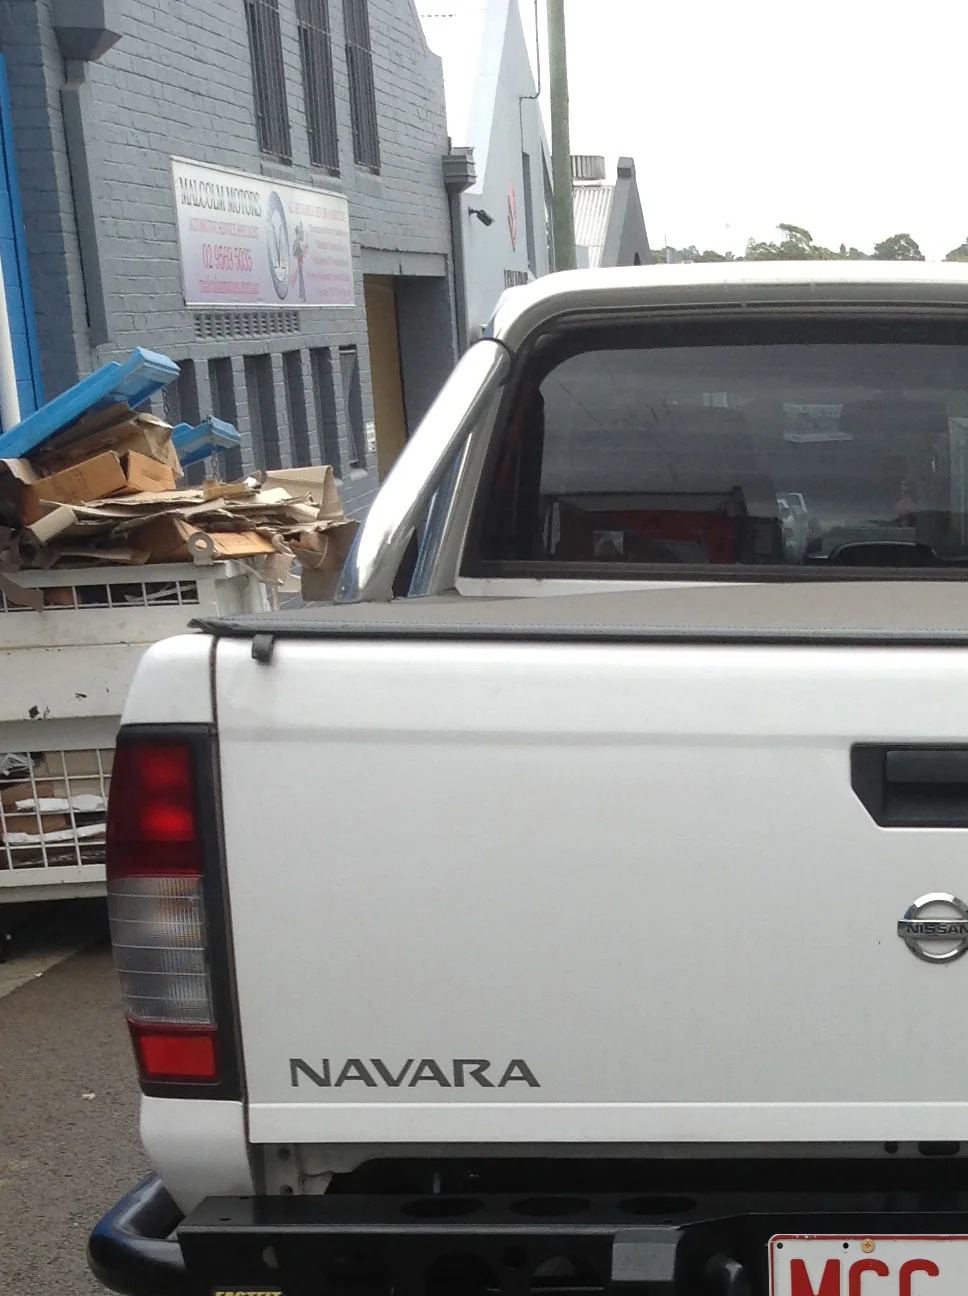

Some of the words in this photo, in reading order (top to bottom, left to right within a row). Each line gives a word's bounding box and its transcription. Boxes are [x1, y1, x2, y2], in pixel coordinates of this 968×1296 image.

[178, 176, 226, 212] MALCOLM
[226, 186, 262, 218] MOTORS
[203, 244, 213, 269] 02
[289, 1057, 542, 1088] NAVARA
